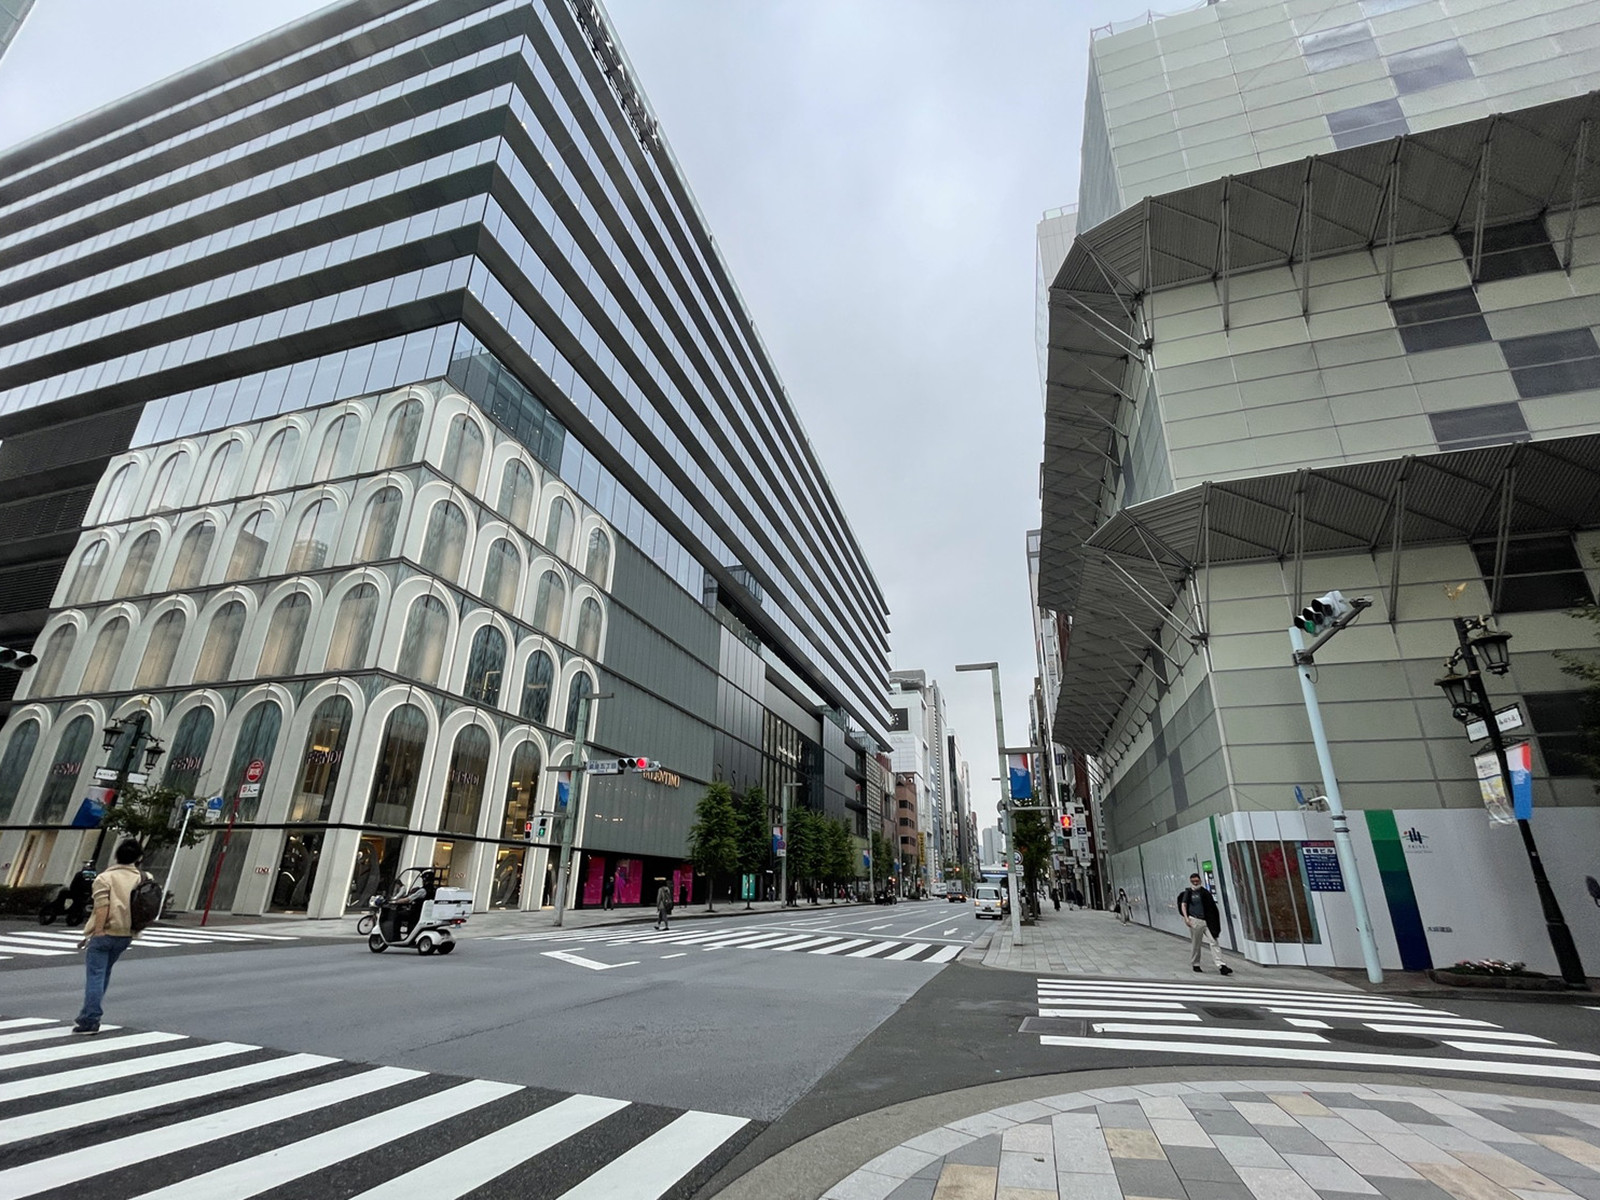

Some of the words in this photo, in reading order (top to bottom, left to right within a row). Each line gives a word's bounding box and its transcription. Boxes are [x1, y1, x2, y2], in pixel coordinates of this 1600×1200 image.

[171, 757, 202, 771] FENDI
[307, 750, 343, 765] FENDI
[451, 769, 480, 785] FENDI
